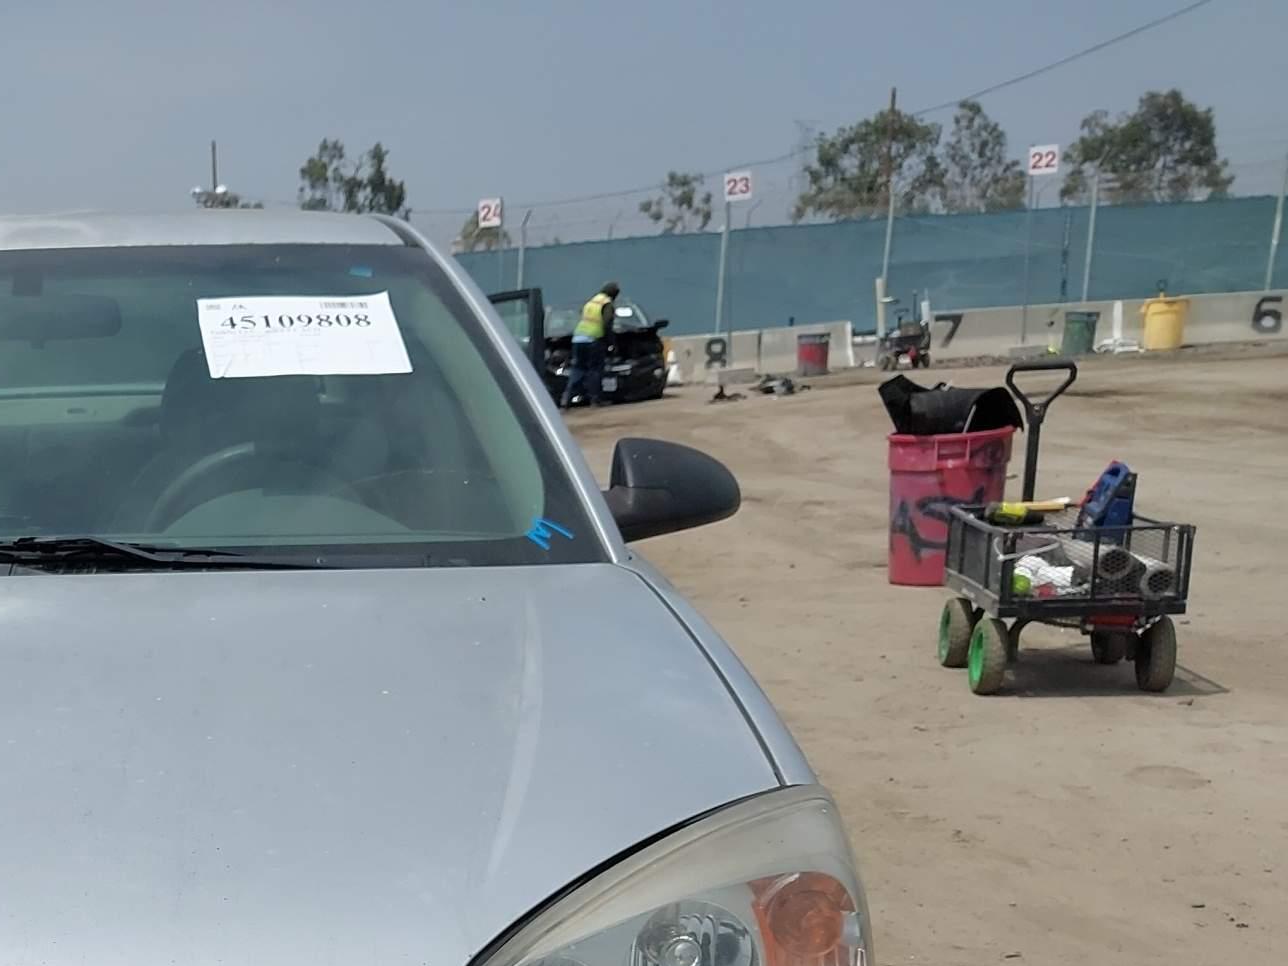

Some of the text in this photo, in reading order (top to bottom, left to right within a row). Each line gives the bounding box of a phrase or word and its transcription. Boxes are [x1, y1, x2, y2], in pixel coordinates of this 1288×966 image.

[1031, 151, 1057, 169] 22
[727, 176, 750, 195] 23
[220, 313, 372, 330] 45109808
[1252, 296, 1283, 334] 6
[935, 313, 964, 348] 7
[705, 338, 727, 369] 8
